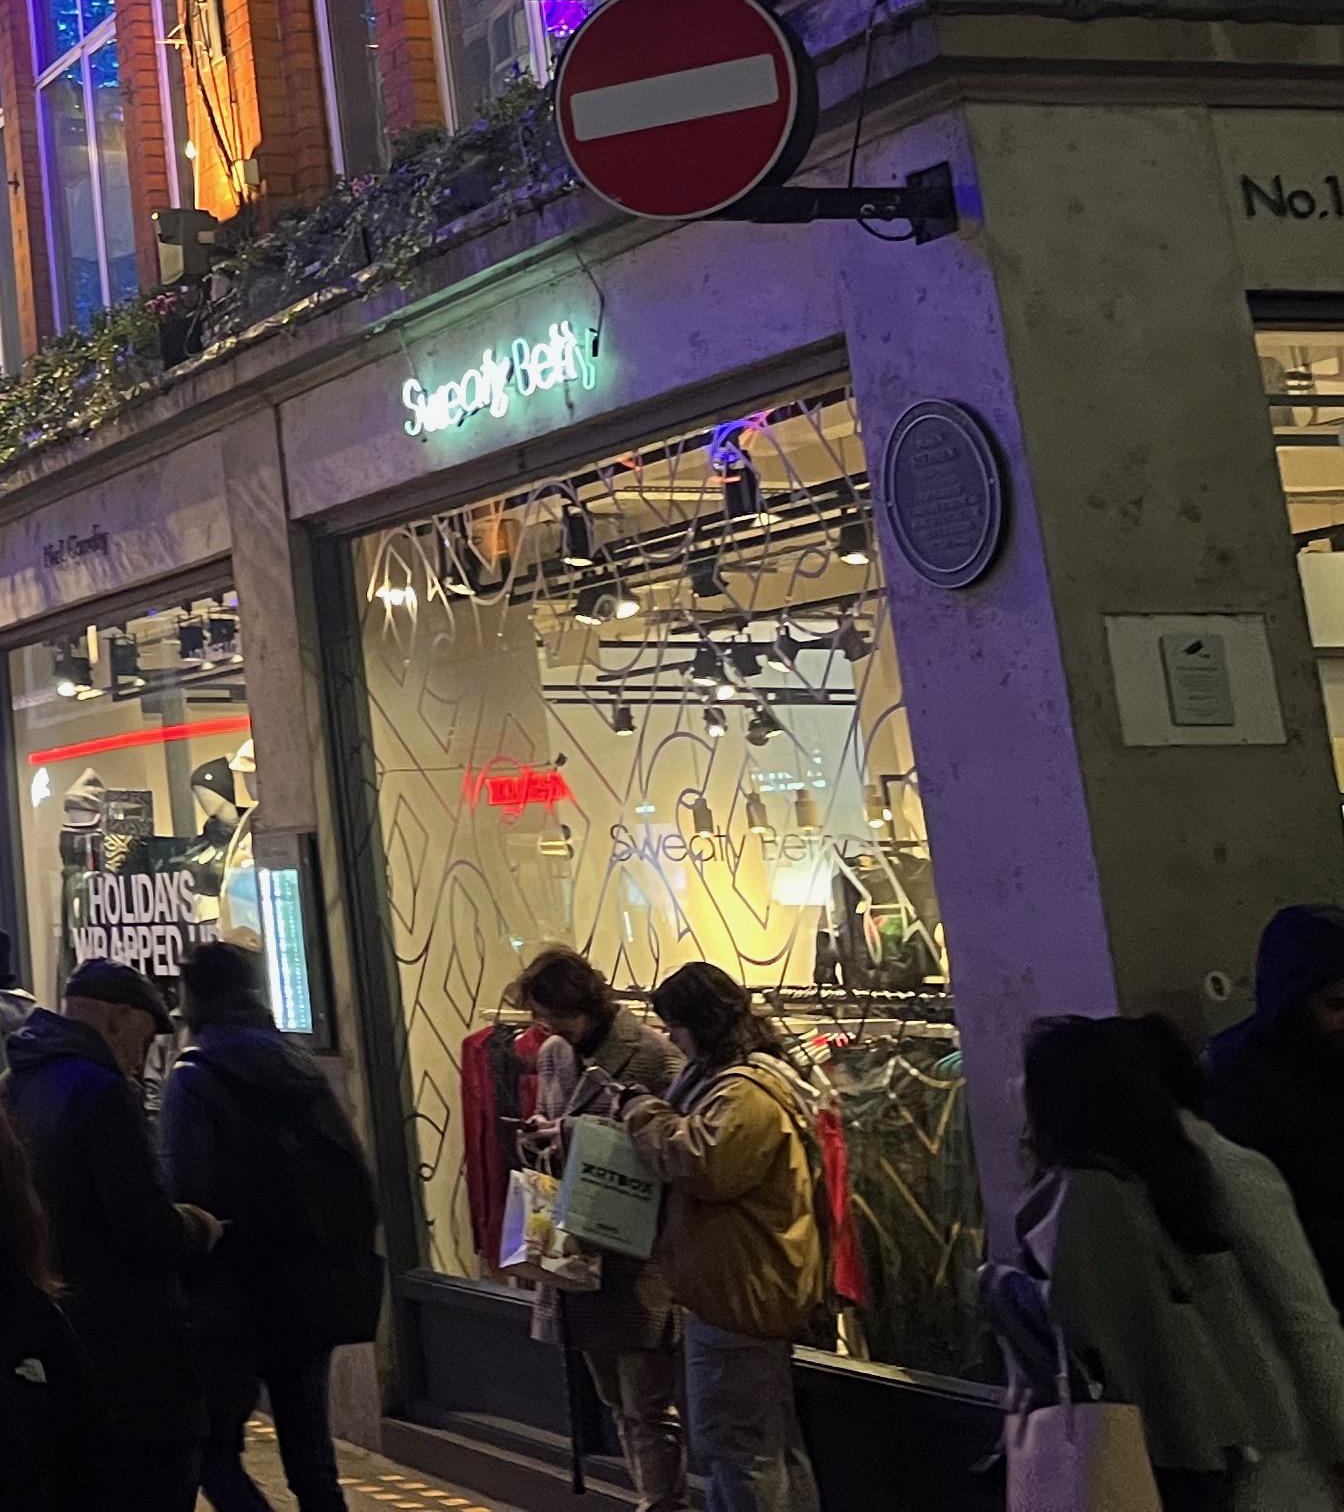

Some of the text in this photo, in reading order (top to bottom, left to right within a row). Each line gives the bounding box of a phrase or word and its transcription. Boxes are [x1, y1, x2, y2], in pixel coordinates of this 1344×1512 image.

[401, 319, 596, 437] Sweaty Betty
[88, 869, 196, 924] HOLIDAYS
